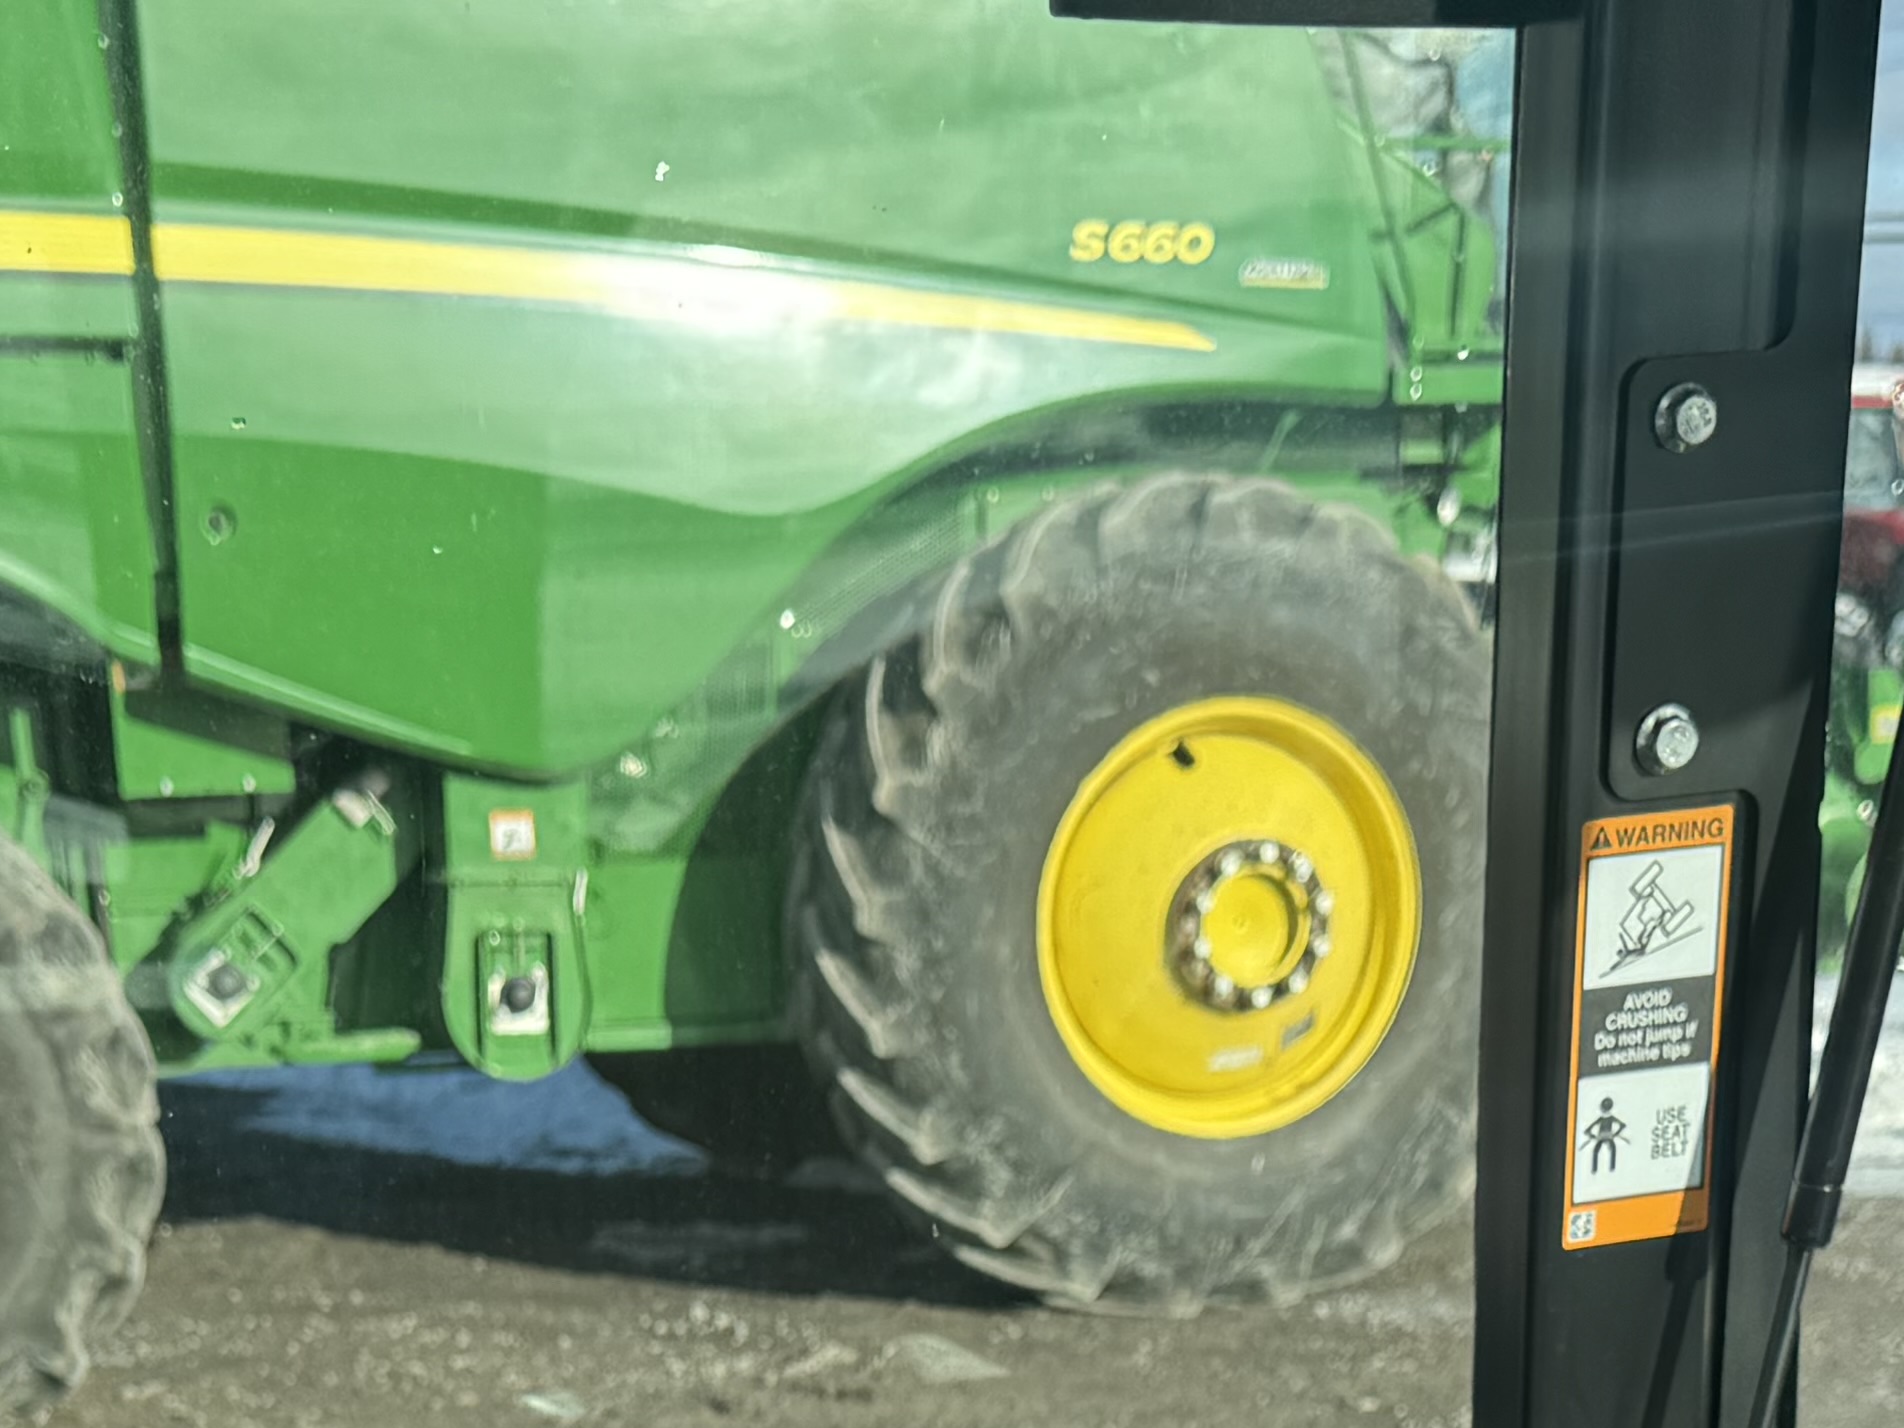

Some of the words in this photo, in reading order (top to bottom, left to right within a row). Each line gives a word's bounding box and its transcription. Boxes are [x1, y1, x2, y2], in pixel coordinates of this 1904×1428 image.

[1070, 218, 1215, 264] S660
[1616, 817, 1724, 848] WARNING
[1623, 987, 1673, 1011] AVOID
[1605, 1002, 1688, 1031] CRUSHING
[1594, 1032, 1616, 1050] Do
[1618, 1028, 1644, 1047] not
[1645, 1025, 1683, 1048] jump
[1686, 1019, 1699, 1039] if
[1598, 1045, 1660, 1067] machine
[1662, 1041, 1692, 1062] tips
[1656, 1105, 1687, 1125] USE
[1651, 1122, 1691, 1143] SEAT
[1651, 1139, 1688, 1160] BELT
